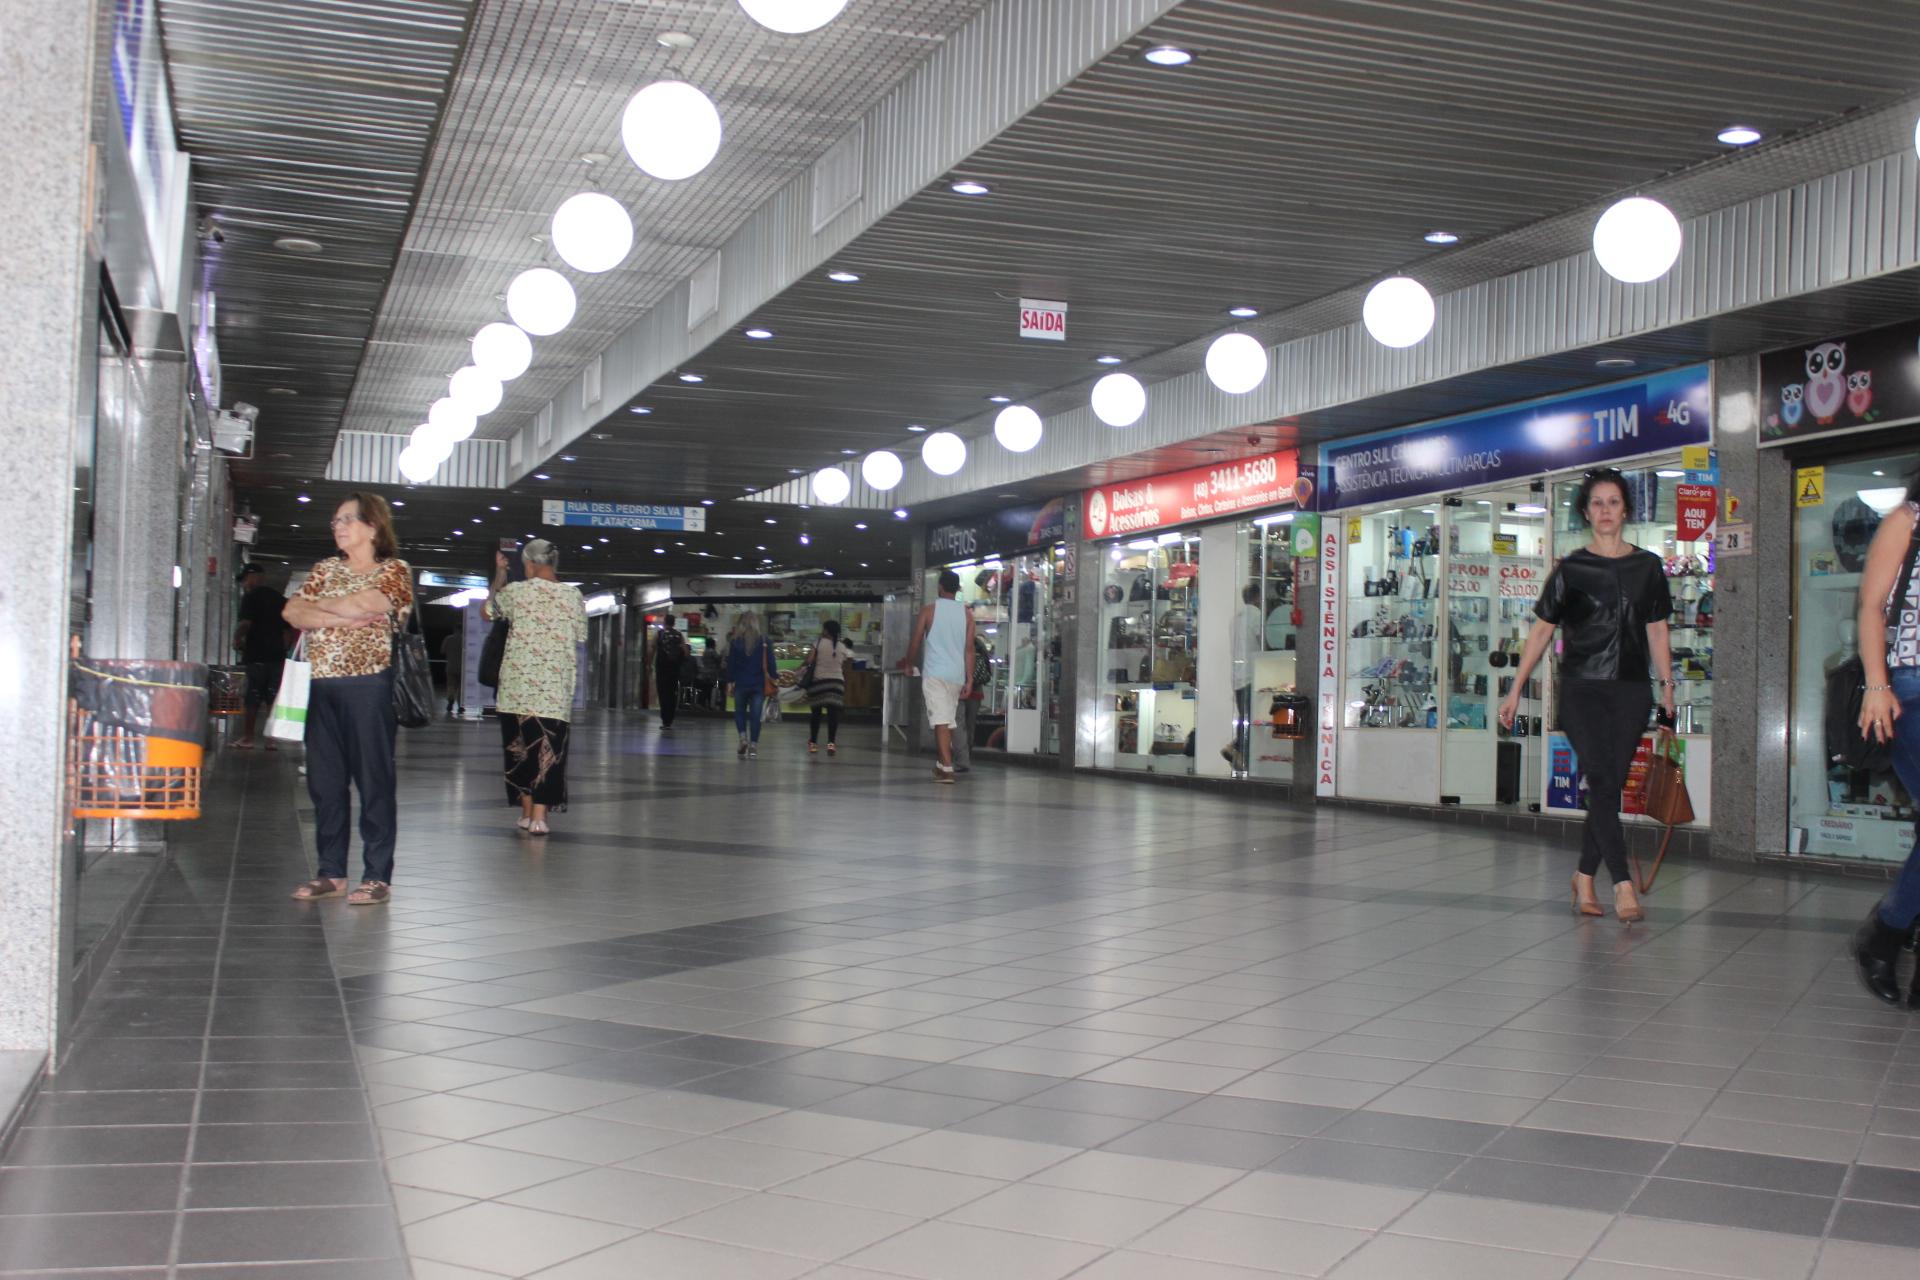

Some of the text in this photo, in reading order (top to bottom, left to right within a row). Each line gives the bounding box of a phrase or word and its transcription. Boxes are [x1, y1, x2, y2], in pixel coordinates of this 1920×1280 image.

[1022, 310, 1063, 331] SAÍDA
[1667, 399, 1690, 425] 4G
[1593, 404, 1638, 442] TIM
[1335, 450, 1372, 471] CENTRO
[1372, 447, 1390, 463] SUL
[1210, 457, 1277, 494] 3411-5680
[1335, 468, 1389, 494] ASSISTÊNCIA
[1429, 449, 1501, 477] MULTIMARCAS
[1698, 473, 1713, 482] TIM
[567, 502, 681, 516] RUA DES. PEDRO SILVA
[1113, 489, 1144, 511] Bolsas
[591, 516, 657, 528] PLATAFORMA
[1109, 506, 1159, 532] Acessórios
[1684, 508, 1706, 519] AQUI
[1685, 519, 1705, 529] TEM
[1727, 533, 1738, 548] 28
[735, 581, 782, 590] Lanchonete
[1323, 533, 1337, 677] ASSISTÊNCIA
[1554, 776, 1570, 788] TIM
[1820, 819, 1853, 830] CREDIÁRIO
